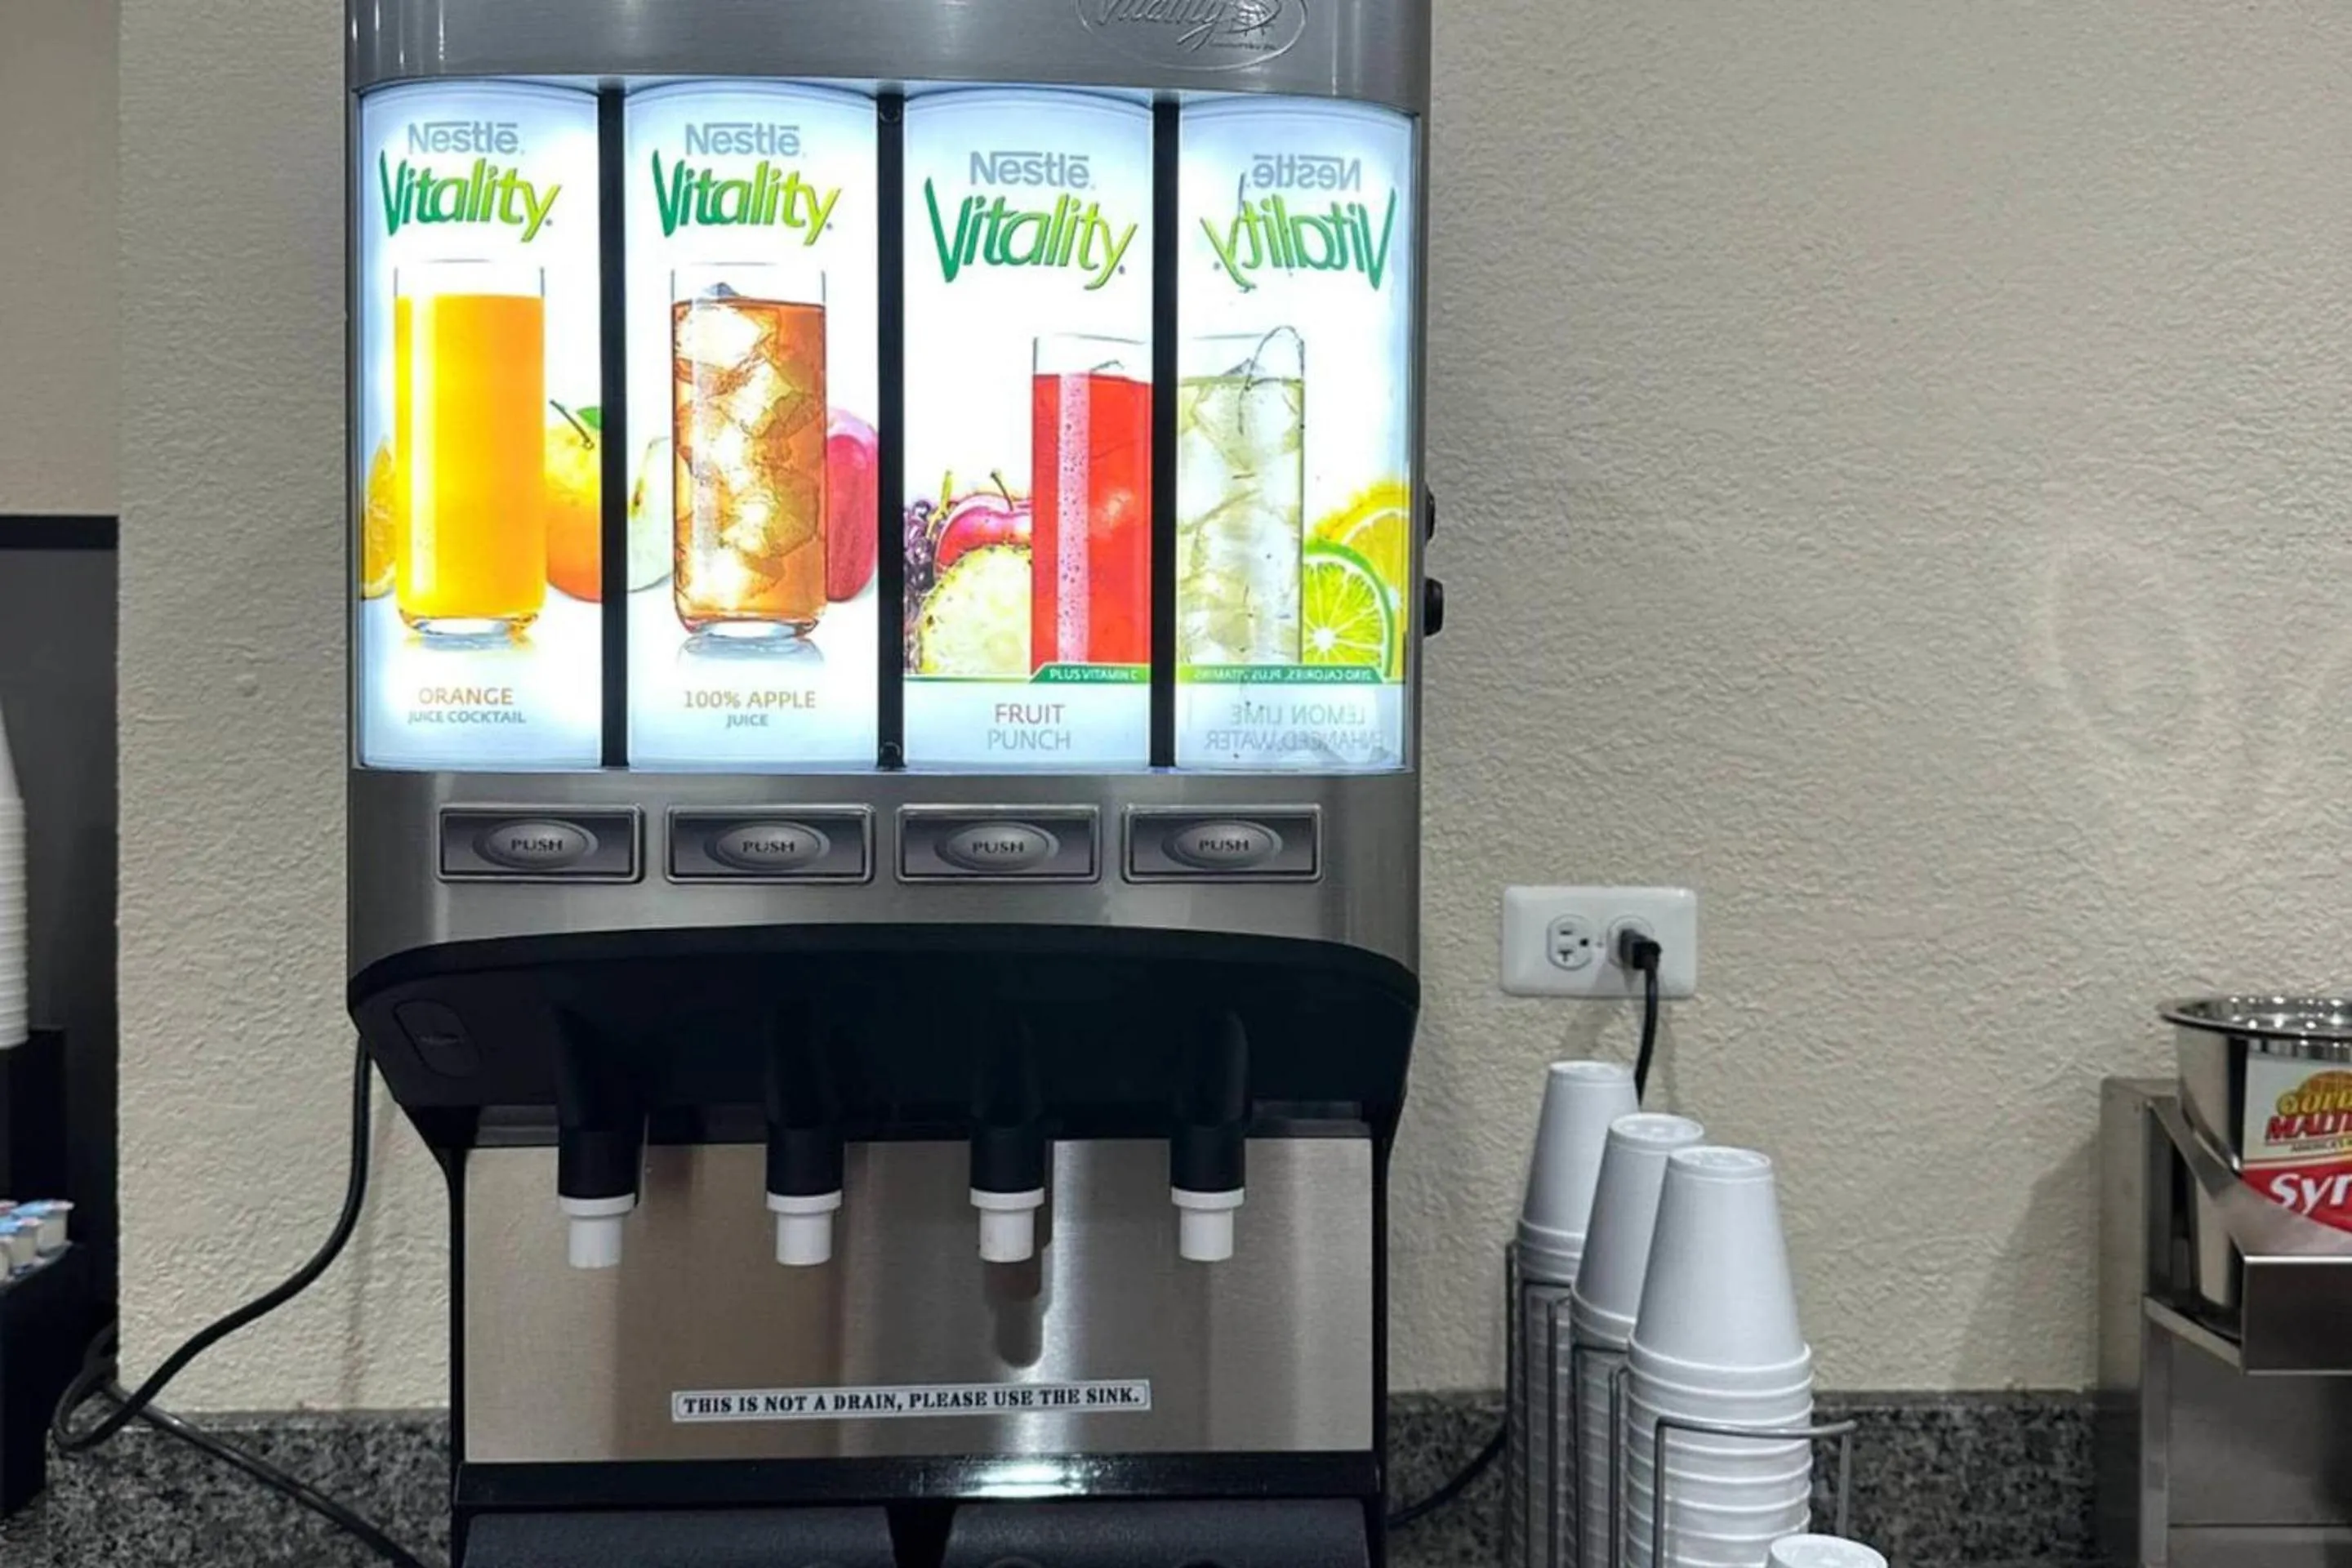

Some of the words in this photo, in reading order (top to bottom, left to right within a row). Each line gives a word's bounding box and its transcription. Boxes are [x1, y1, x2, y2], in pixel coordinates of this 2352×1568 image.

[380, 149, 561, 243] Vitality
[652, 150, 841, 246] Vitality
[924, 176, 1138, 290] Vitality
[418, 687, 514, 706] ORANGE
[684, 690, 742, 709] 100%
[746, 690, 816, 710] APPLE
[408, 710, 444, 725] JUICE
[448, 710, 527, 724] COCKTAIL
[725, 714, 769, 729] JUICE
[995, 702, 1067, 725] FRUIT
[987, 728, 1071, 751] PUNCH
[511, 837, 563, 853] PUSH
[742, 840, 795, 853] PUSH
[972, 840, 1025, 853] PUSH
[1198, 837, 1250, 852] PUSH
[684, 1397, 732, 1414] THIS
[739, 1396, 758, 1413] IS
[764, 1395, 807, 1412] NOT
[813, 1395, 826, 1411] A
[833, 1393, 903, 1411] DRAIN,
[908, 1391, 987, 1409] PLEASE
[993, 1390, 1034, 1406] USE
[1040, 1388, 1080, 1405] THE
[1086, 1387, 1140, 1405] SINK.
